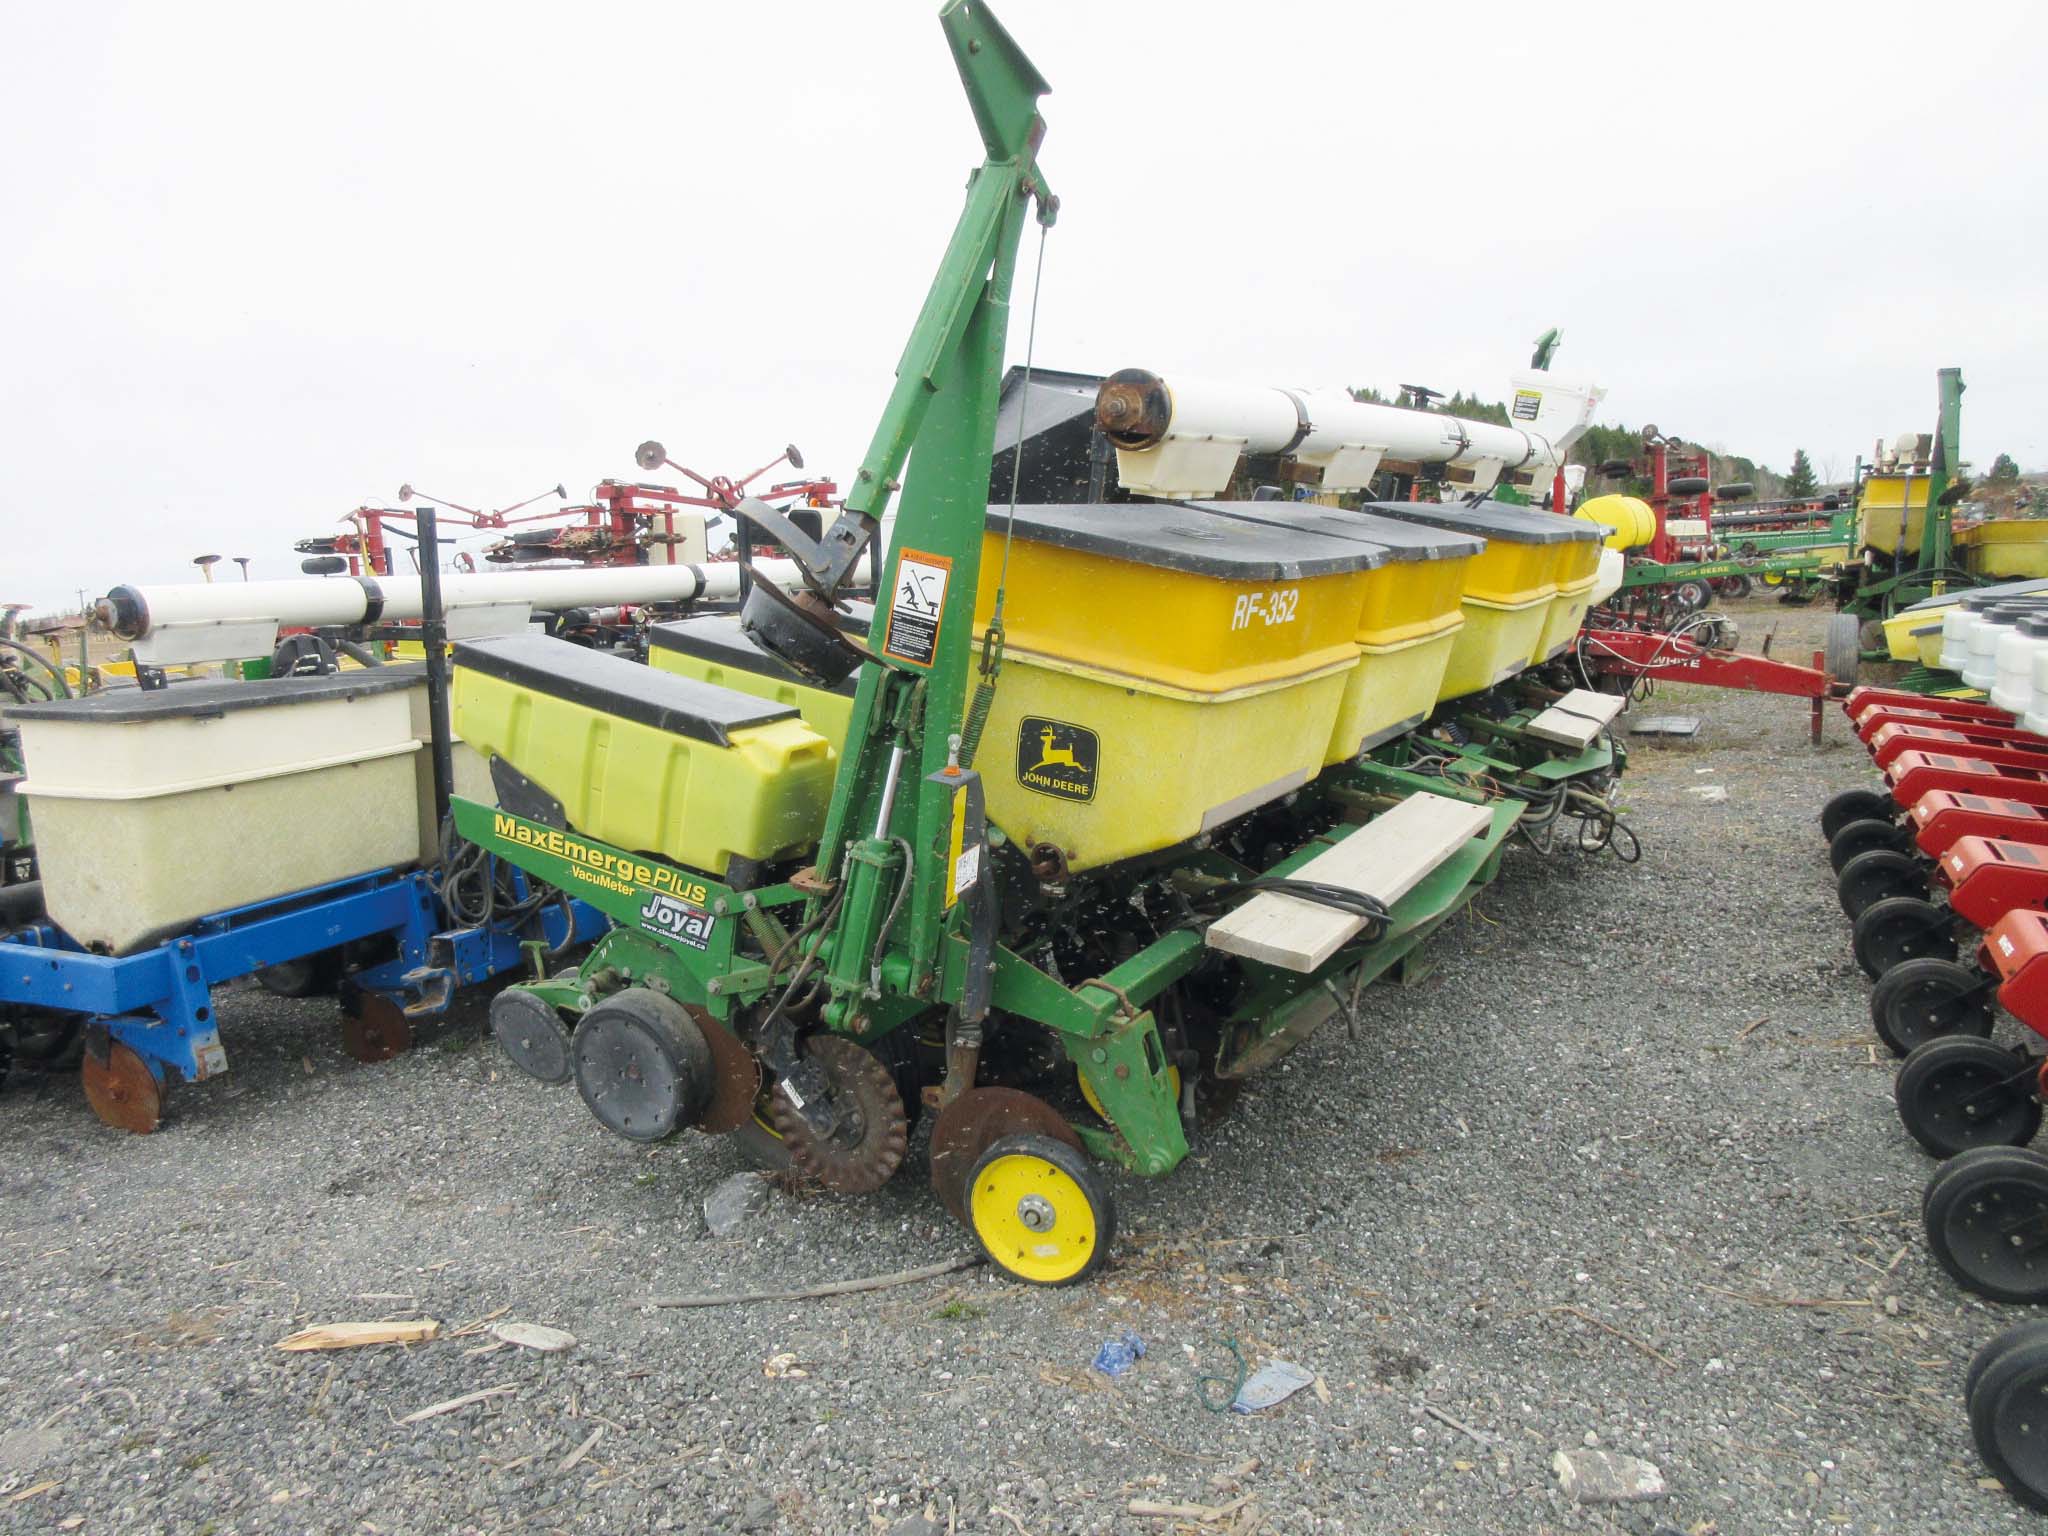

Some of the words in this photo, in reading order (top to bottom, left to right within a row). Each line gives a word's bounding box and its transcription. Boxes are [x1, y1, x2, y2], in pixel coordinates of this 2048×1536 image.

[1231, 588, 1299, 632] RF-352
[1022, 771, 1051, 787] JOHN
[1053, 778, 1089, 796] DEERE
[571, 864, 636, 897] VacuMeter
[641, 894, 715, 939] Joyal
